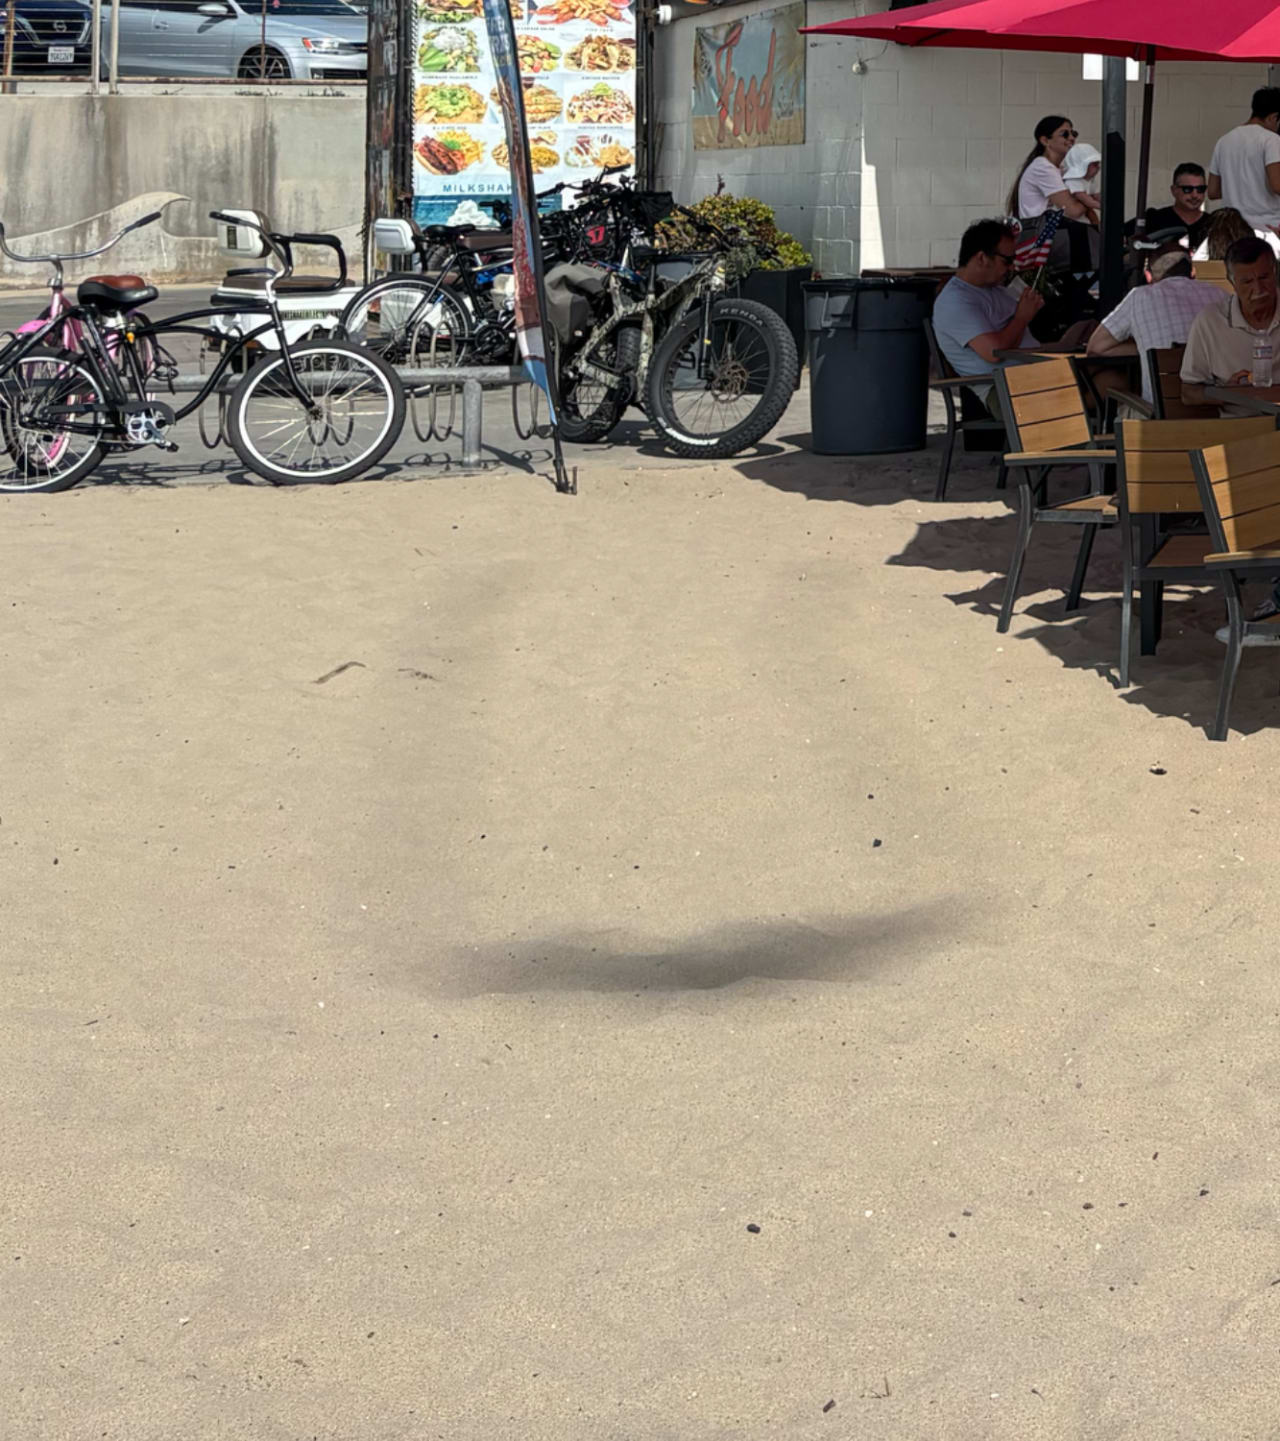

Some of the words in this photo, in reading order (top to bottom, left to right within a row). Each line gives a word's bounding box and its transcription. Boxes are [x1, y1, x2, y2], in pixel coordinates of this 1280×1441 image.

[715, 22, 777, 143] Food
[442, 184, 513, 193] MILKSHAK
[720, 308, 764, 326] KENDA
